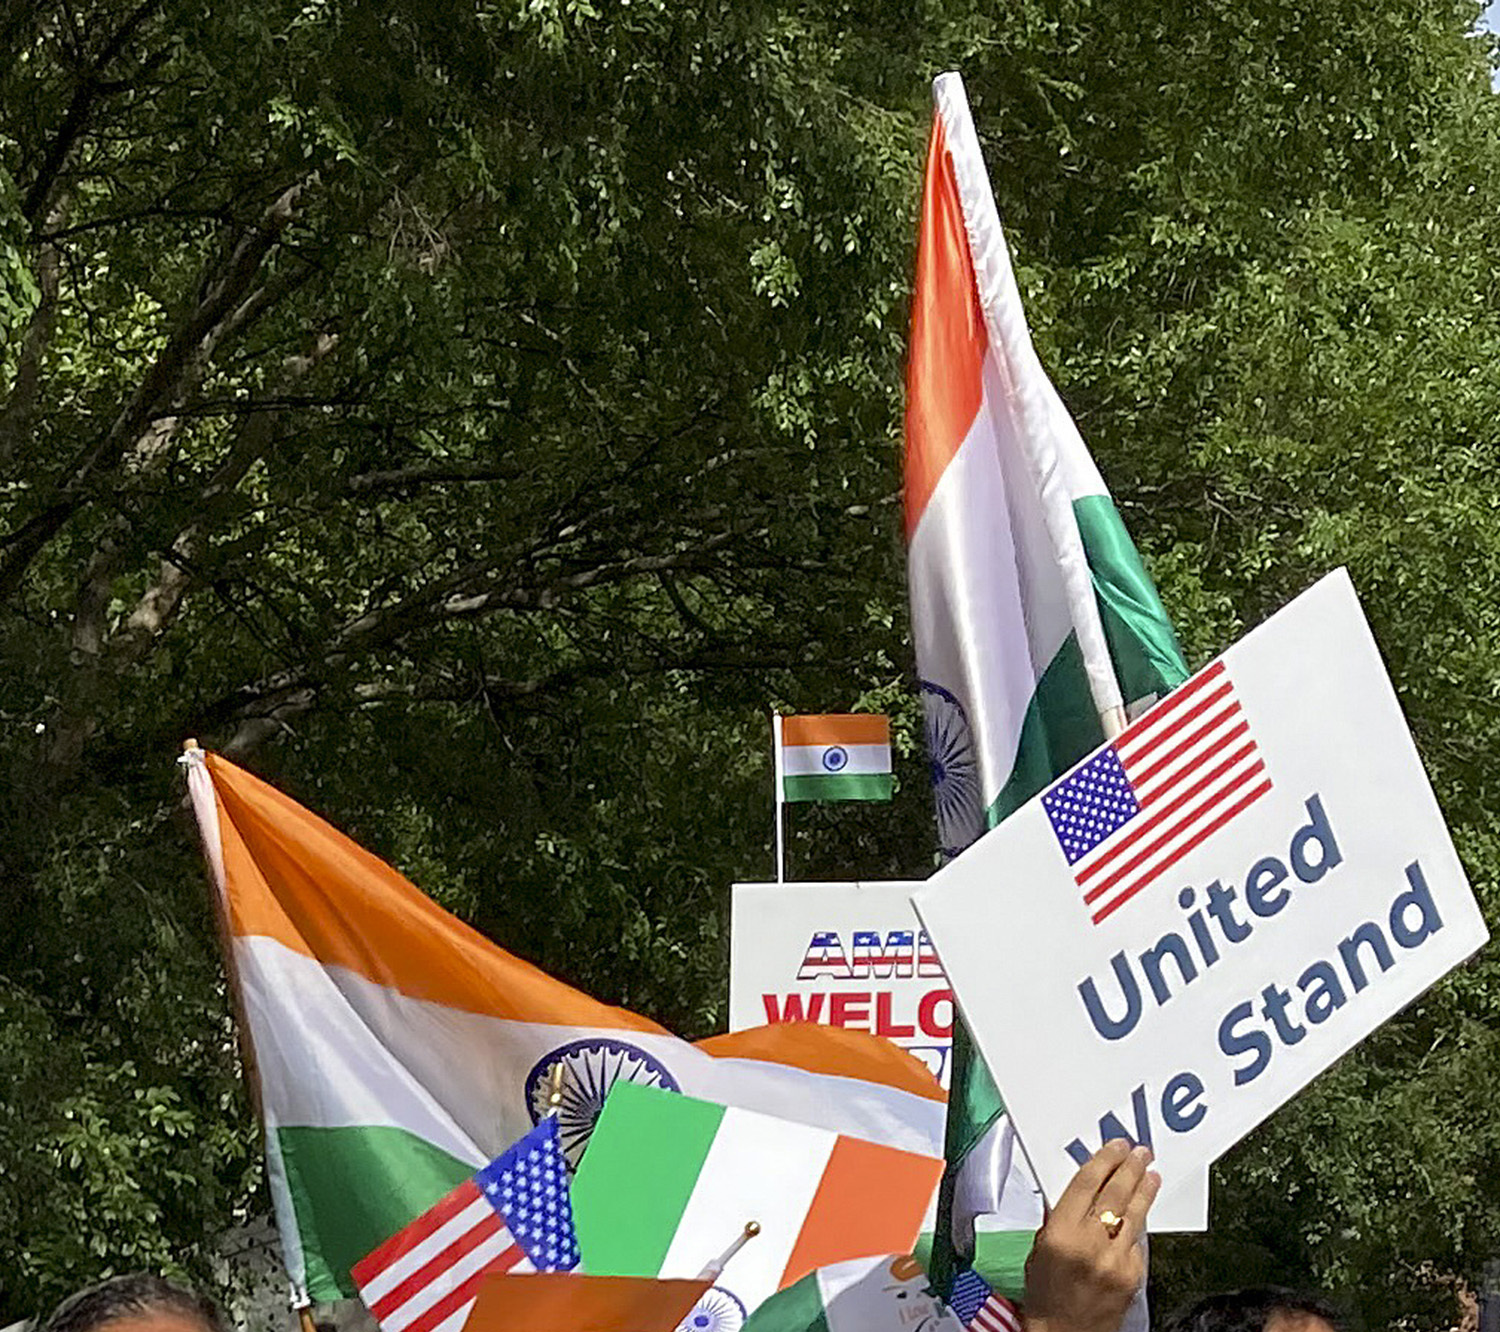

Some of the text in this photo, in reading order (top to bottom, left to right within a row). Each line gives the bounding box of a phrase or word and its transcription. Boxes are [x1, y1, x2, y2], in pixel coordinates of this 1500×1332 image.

[1064, 860, 1444, 1169] We Stand
[1078, 793, 1344, 1040] United
